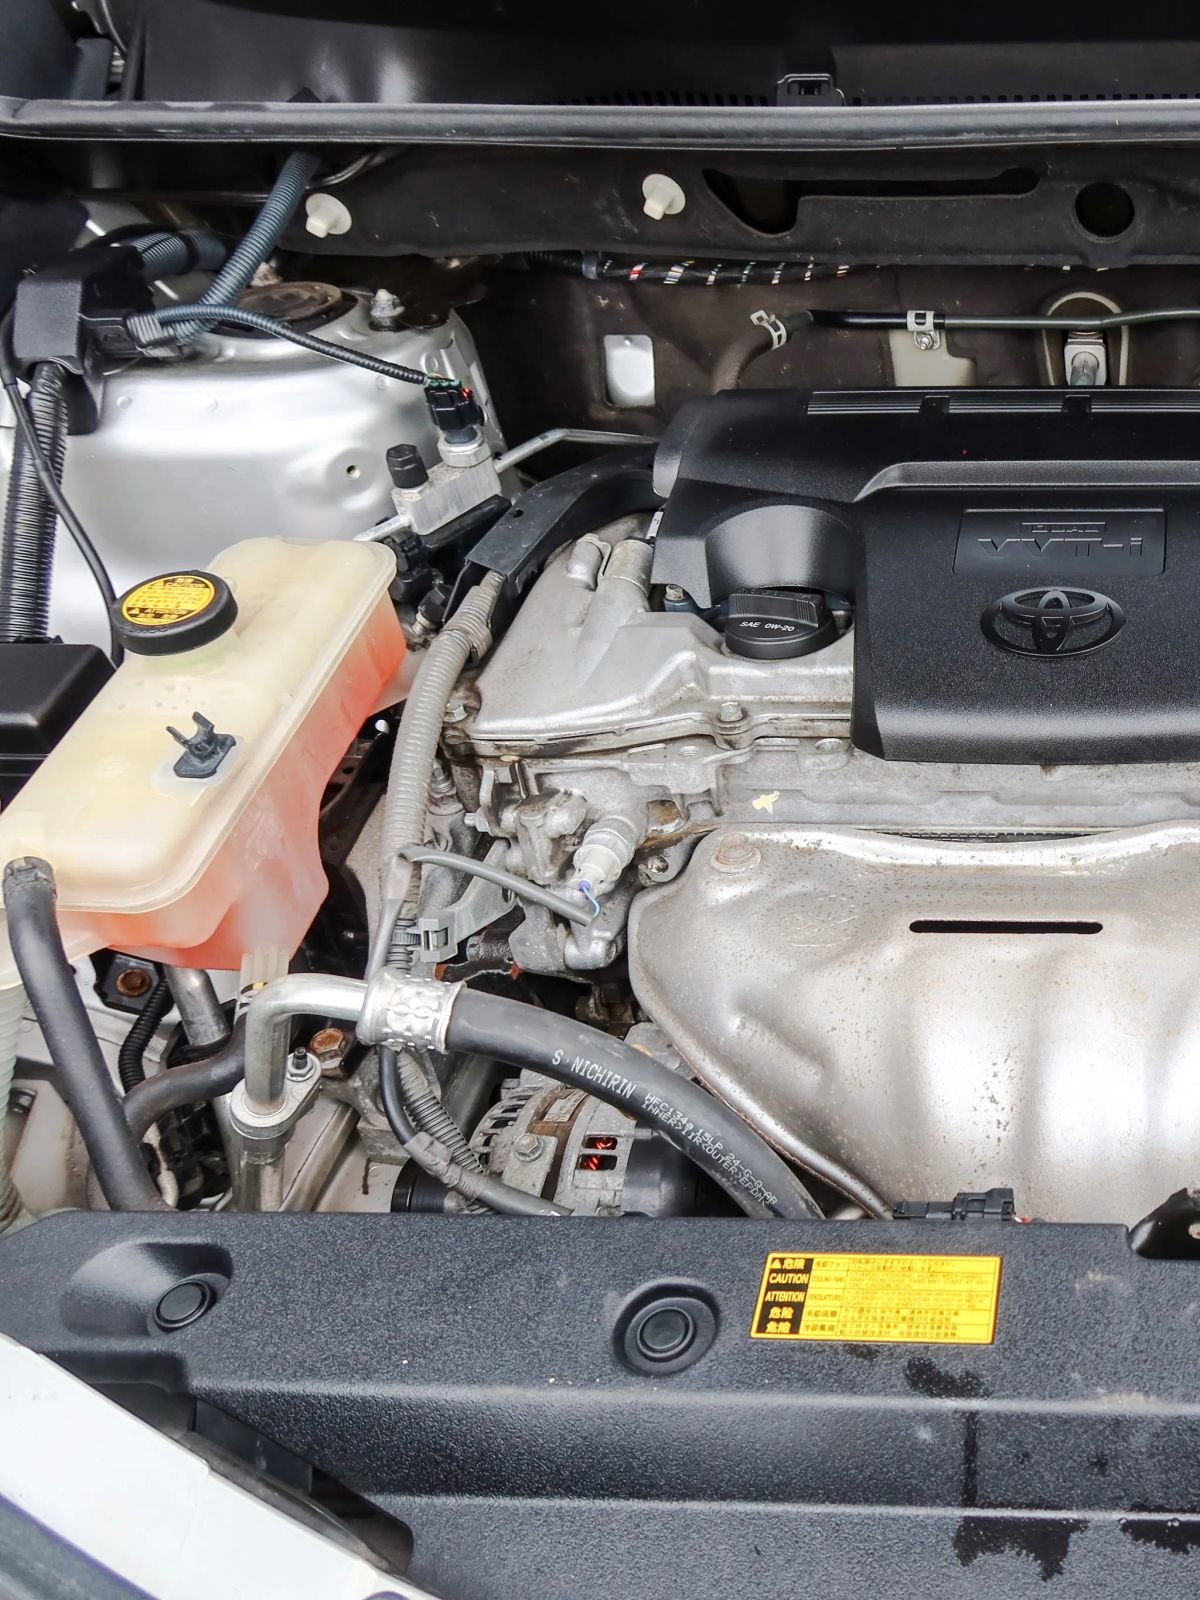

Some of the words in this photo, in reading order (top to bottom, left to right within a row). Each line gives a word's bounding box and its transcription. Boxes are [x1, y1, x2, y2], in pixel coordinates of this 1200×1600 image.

[977, 536, 1144, 558] VVT-i
[769, 1273, 809, 1284] CAUTION
[765, 1291, 805, 1302] ATTENTION
